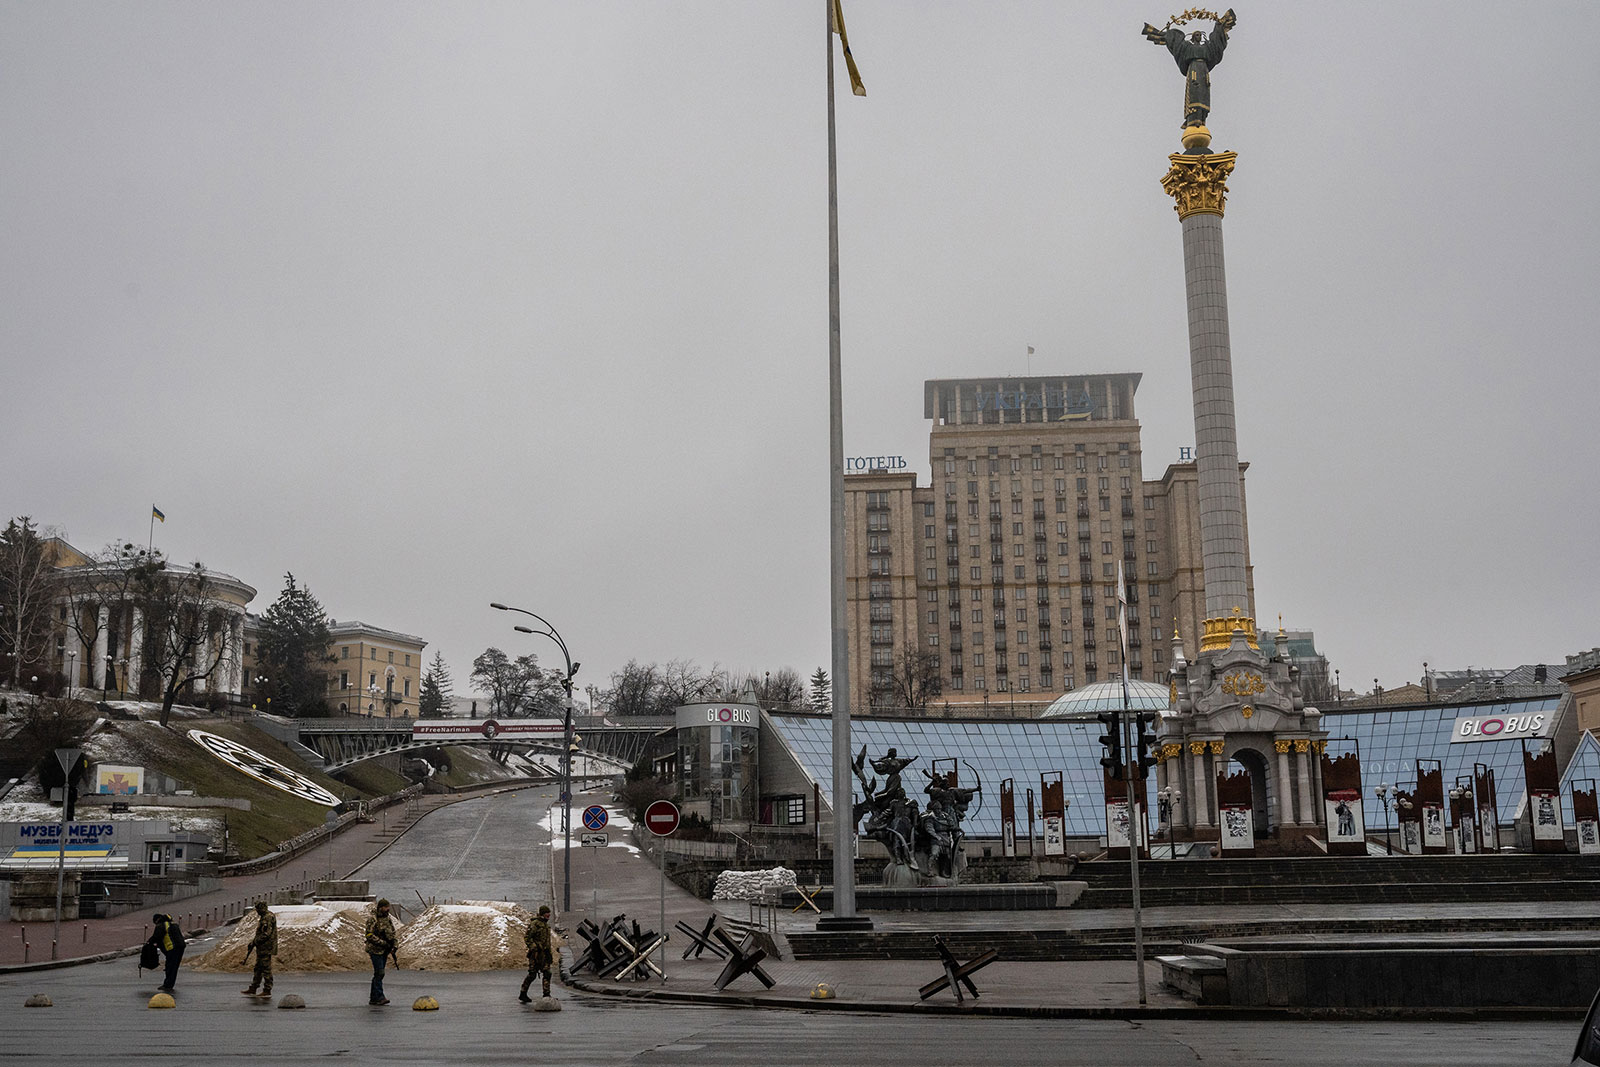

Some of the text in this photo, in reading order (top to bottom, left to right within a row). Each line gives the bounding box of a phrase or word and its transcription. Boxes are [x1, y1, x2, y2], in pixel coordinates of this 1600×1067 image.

[975, 389, 1093, 411] УКРАЇНА
[846, 456, 907, 470] ГОТЕЛЬ
[707, 708, 751, 723] GLOBUS
[1459, 714, 1544, 736] GLOBUS
[20, 823, 113, 838] МУЗЕЙ МЕДУЗ
